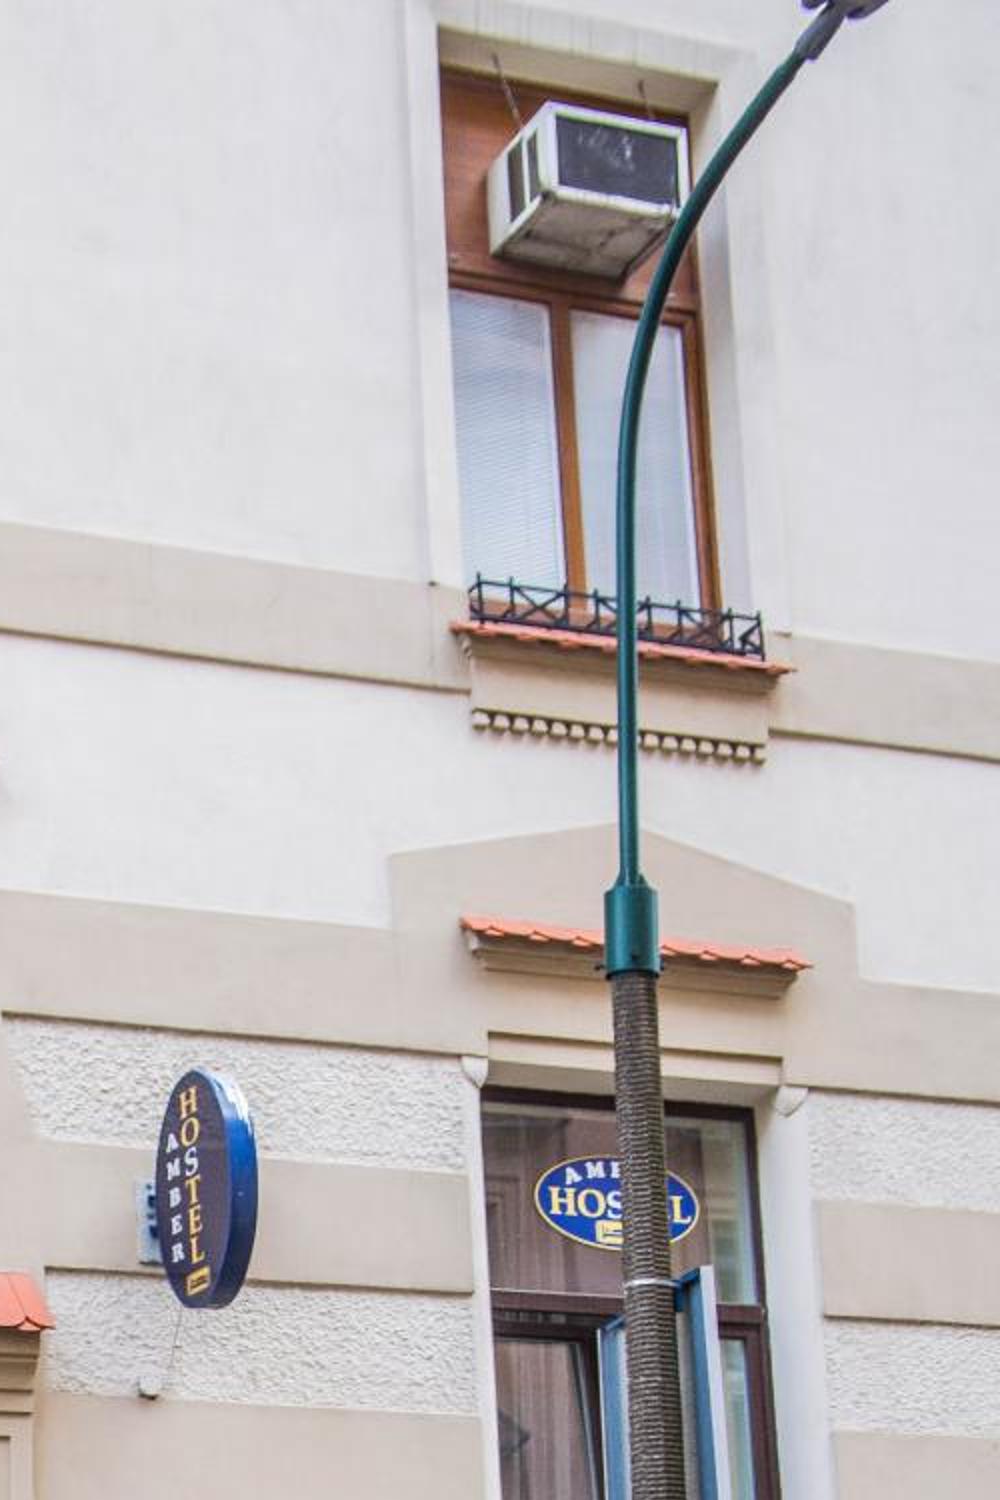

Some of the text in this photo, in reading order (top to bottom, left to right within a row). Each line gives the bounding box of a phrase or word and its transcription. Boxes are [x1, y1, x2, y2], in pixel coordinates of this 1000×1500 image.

[165, 1133, 186, 1263] AMBER
[178, 1087, 206, 1265] HOSTEL
[548, 1186, 692, 1224] HOSL
